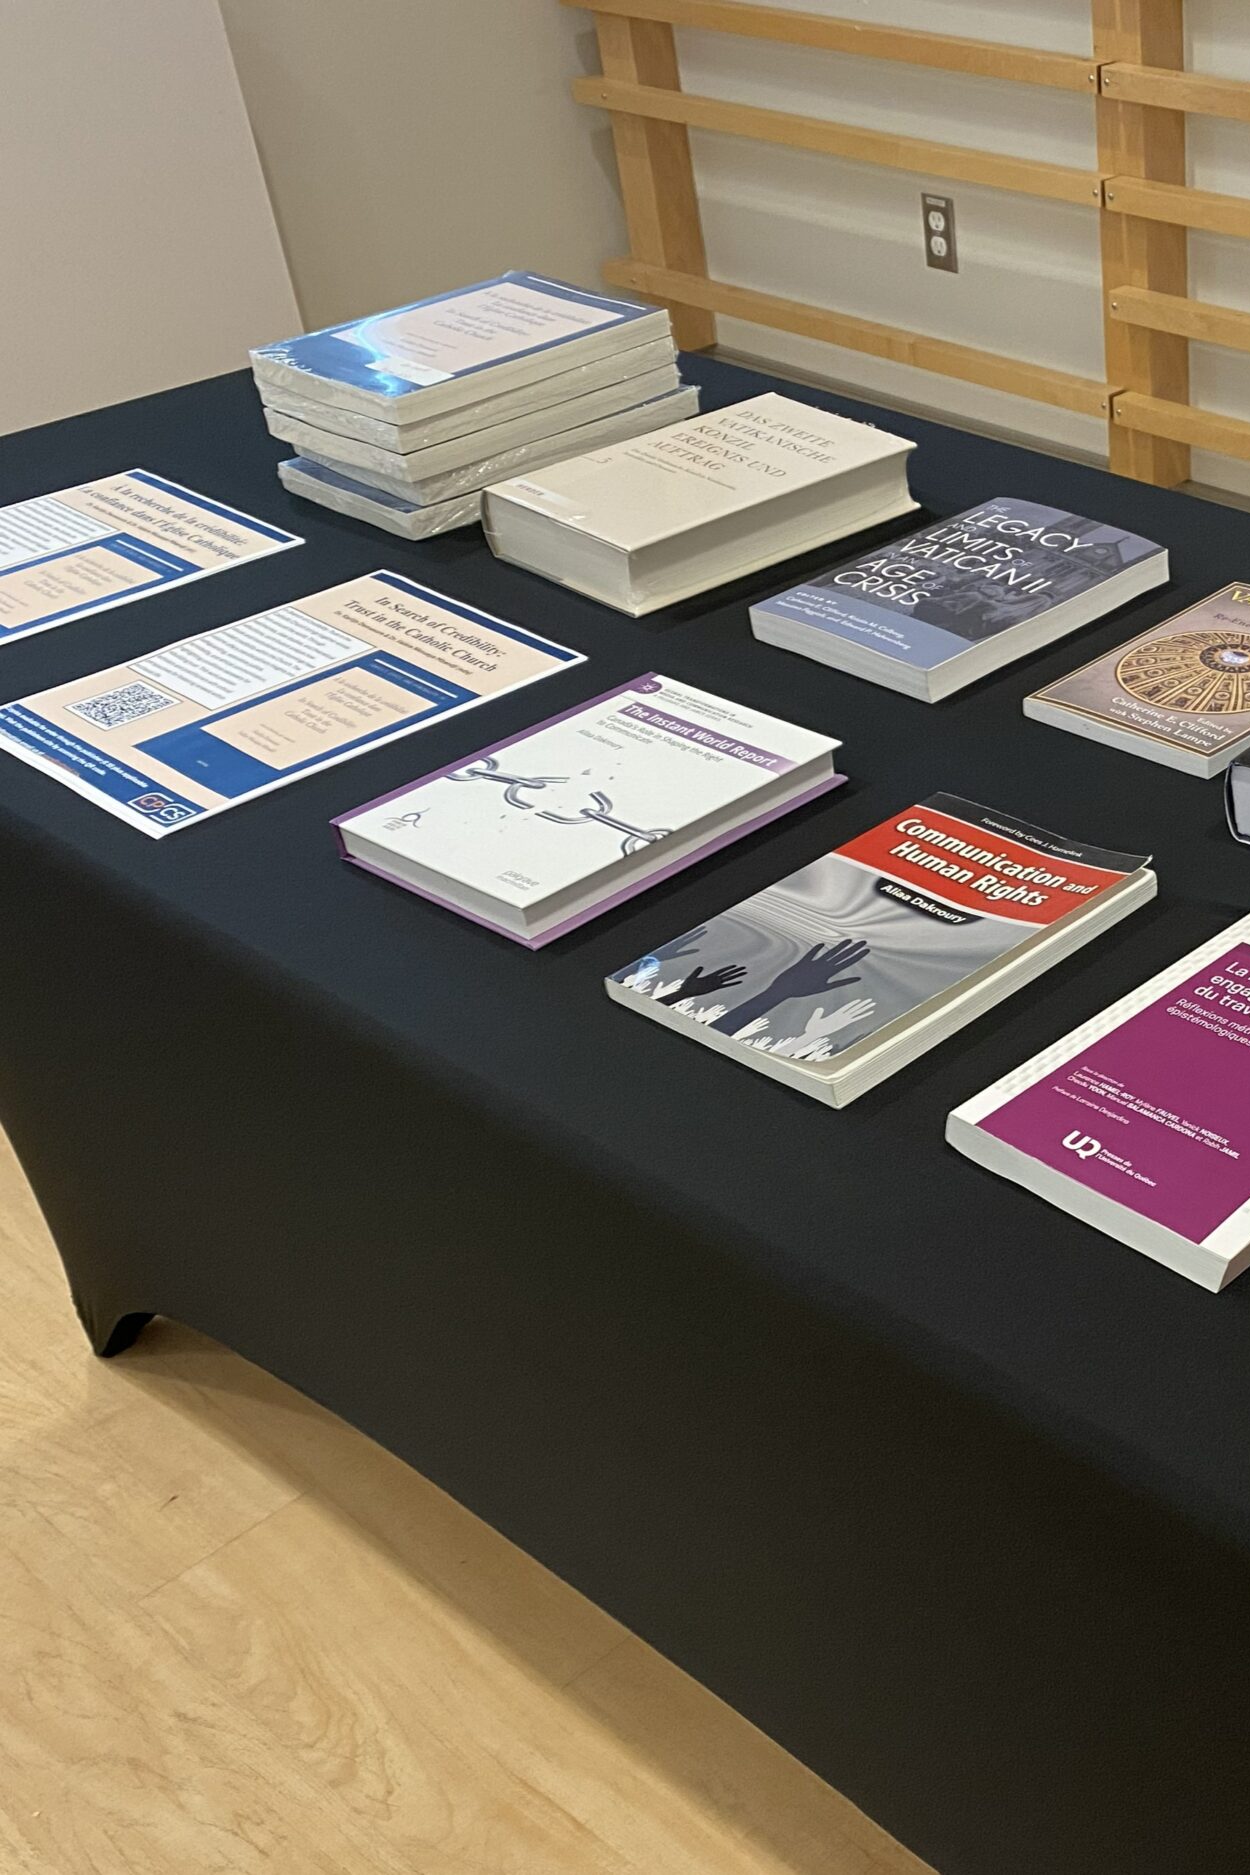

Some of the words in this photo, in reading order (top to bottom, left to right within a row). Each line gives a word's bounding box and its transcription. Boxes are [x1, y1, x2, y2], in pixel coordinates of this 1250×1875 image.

[693, 425, 757, 450] KONZIL
[717, 417, 838, 464] VATIKANISCHE
[736, 411, 768, 424] DAS
[768, 422, 835, 448] ZWEITE
[648, 441, 725, 471] AUFTRAG
[670, 432, 750, 463] EREIGNIS
[747, 461, 787, 478] UND
[948, 523, 977, 533] AND
[985, 504, 1012, 513] THE
[925, 528, 1024, 561] LIMITS
[1011, 558, 1032, 568] OF
[962, 511, 1094, 553] LEGACY
[855, 558, 936, 585] AGE
[921, 582, 945, 591] OF
[898, 556, 920, 564] AN
[900, 539, 1032, 586] VATICAN
[1021, 579, 1053, 594] II
[833, 571, 931, 605] CRISIS
[344, 600, 376, 617] Trust
[376, 614, 388, 622] in
[390, 618, 406, 630] the
[404, 627, 454, 652] Catholic
[451, 648, 498, 673] Church
[374, 596, 390, 607] In
[389, 602, 428, 625] Search
[428, 617, 443, 629] of
[439, 626, 508, 657] Credibility:
[625, 705, 646, 719] The
[647, 712, 695, 735] Instant
[692, 731, 732, 750] World
[729, 746, 778, 768] Report
[1109, 708, 1127, 716] with
[1128, 712, 1172, 732] Stephen
[1174, 729, 1212, 747] Lampe
[1112, 697, 1164, 719] Catherine
[1166, 715, 1177, 724] E.
[1179, 720, 1227, 741] Clifford
[895, 818, 1067, 887] Communication
[1062, 882, 1099, 895] and
[982, 818, 1015, 835] Foreword
[1014, 829, 1025, 838] by
[1025, 833, 1043, 845] Cees
[1041, 839, 1050, 848] J.
[1049, 842, 1083, 858] Hamelink
[889, 841, 974, 884] Human
[970, 874, 1049, 906] Rights
[881, 884, 910, 900] Aliaa
[910, 897, 967, 923] Dakroury
[1225, 962, 1248, 977] La
[1176, 998, 1229, 1025] Réflexions
[1194, 986, 1219, 1001] du
[1095, 1154, 1127, 1172] l'Université
[1126, 1168, 1135, 1176] du
[1134, 1172, 1157, 1187] Québec
[1100, 1149, 1123, 1162] Presses
[1122, 1159, 1132, 1167] de
